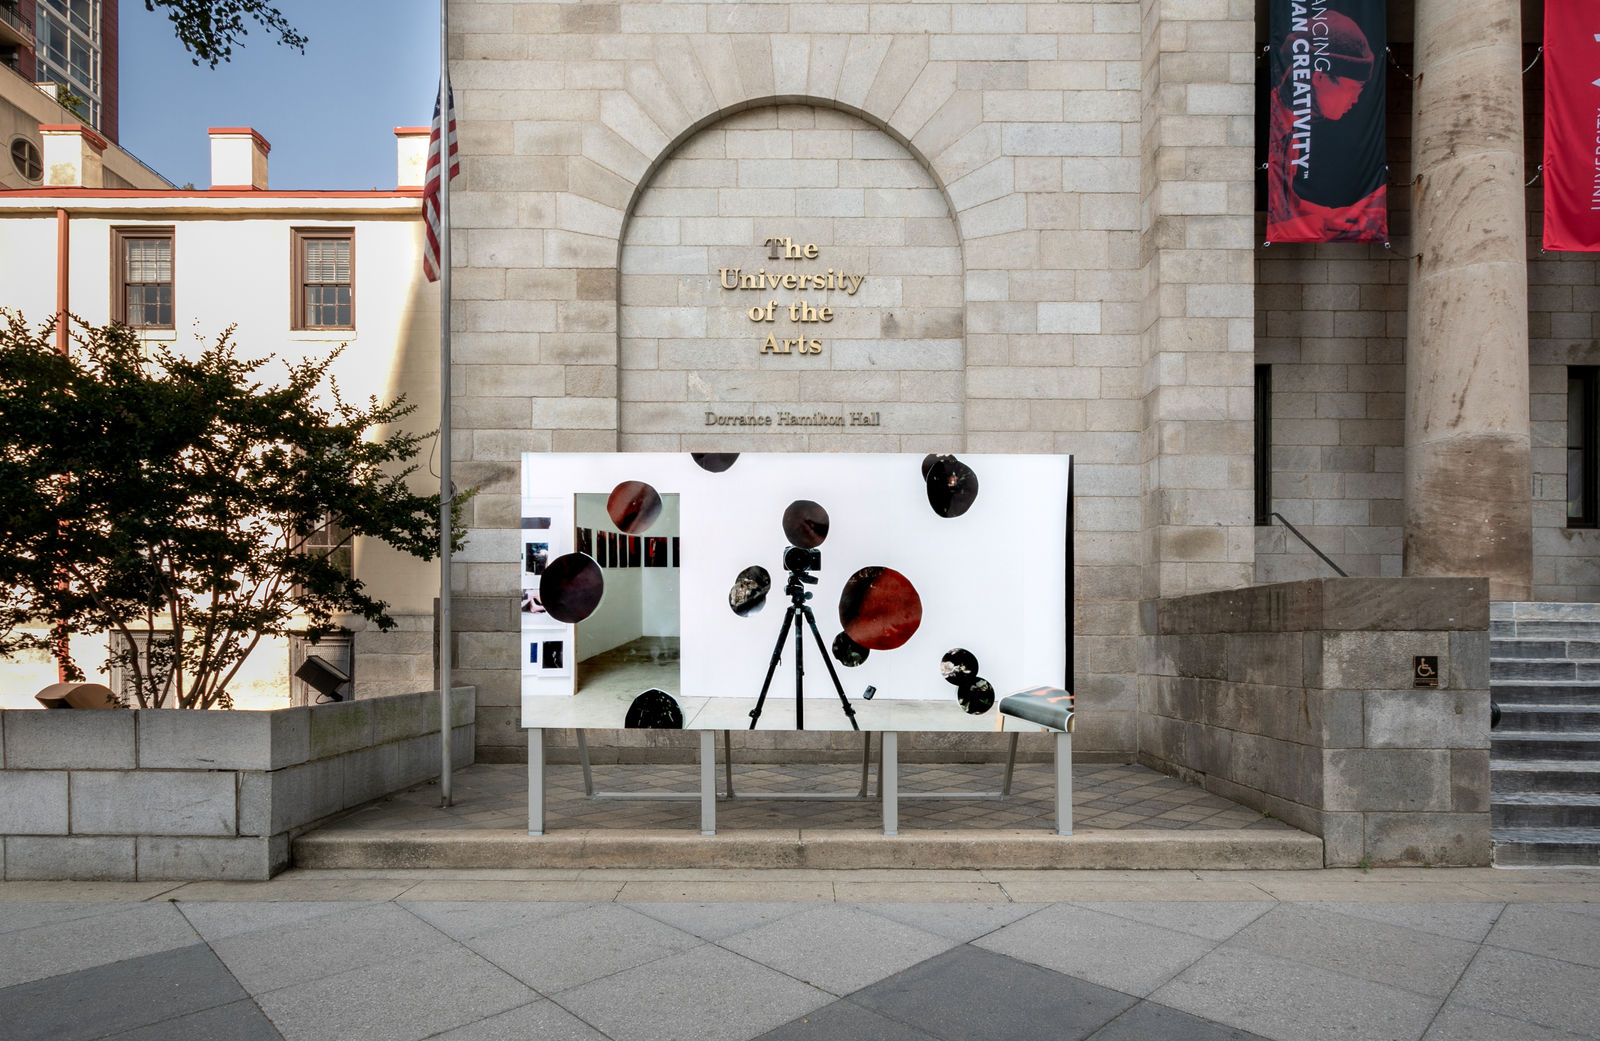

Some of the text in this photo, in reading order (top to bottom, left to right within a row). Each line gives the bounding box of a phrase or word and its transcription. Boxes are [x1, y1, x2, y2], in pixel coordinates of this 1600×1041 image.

[1291, 0, 1308, 32] AN
[764, 237, 819, 259] The
[719, 267, 864, 295] University
[748, 300, 834, 323] of the
[760, 331, 823, 355] Arts
[704, 411, 880, 426] Dorrance Hamilton Hall
